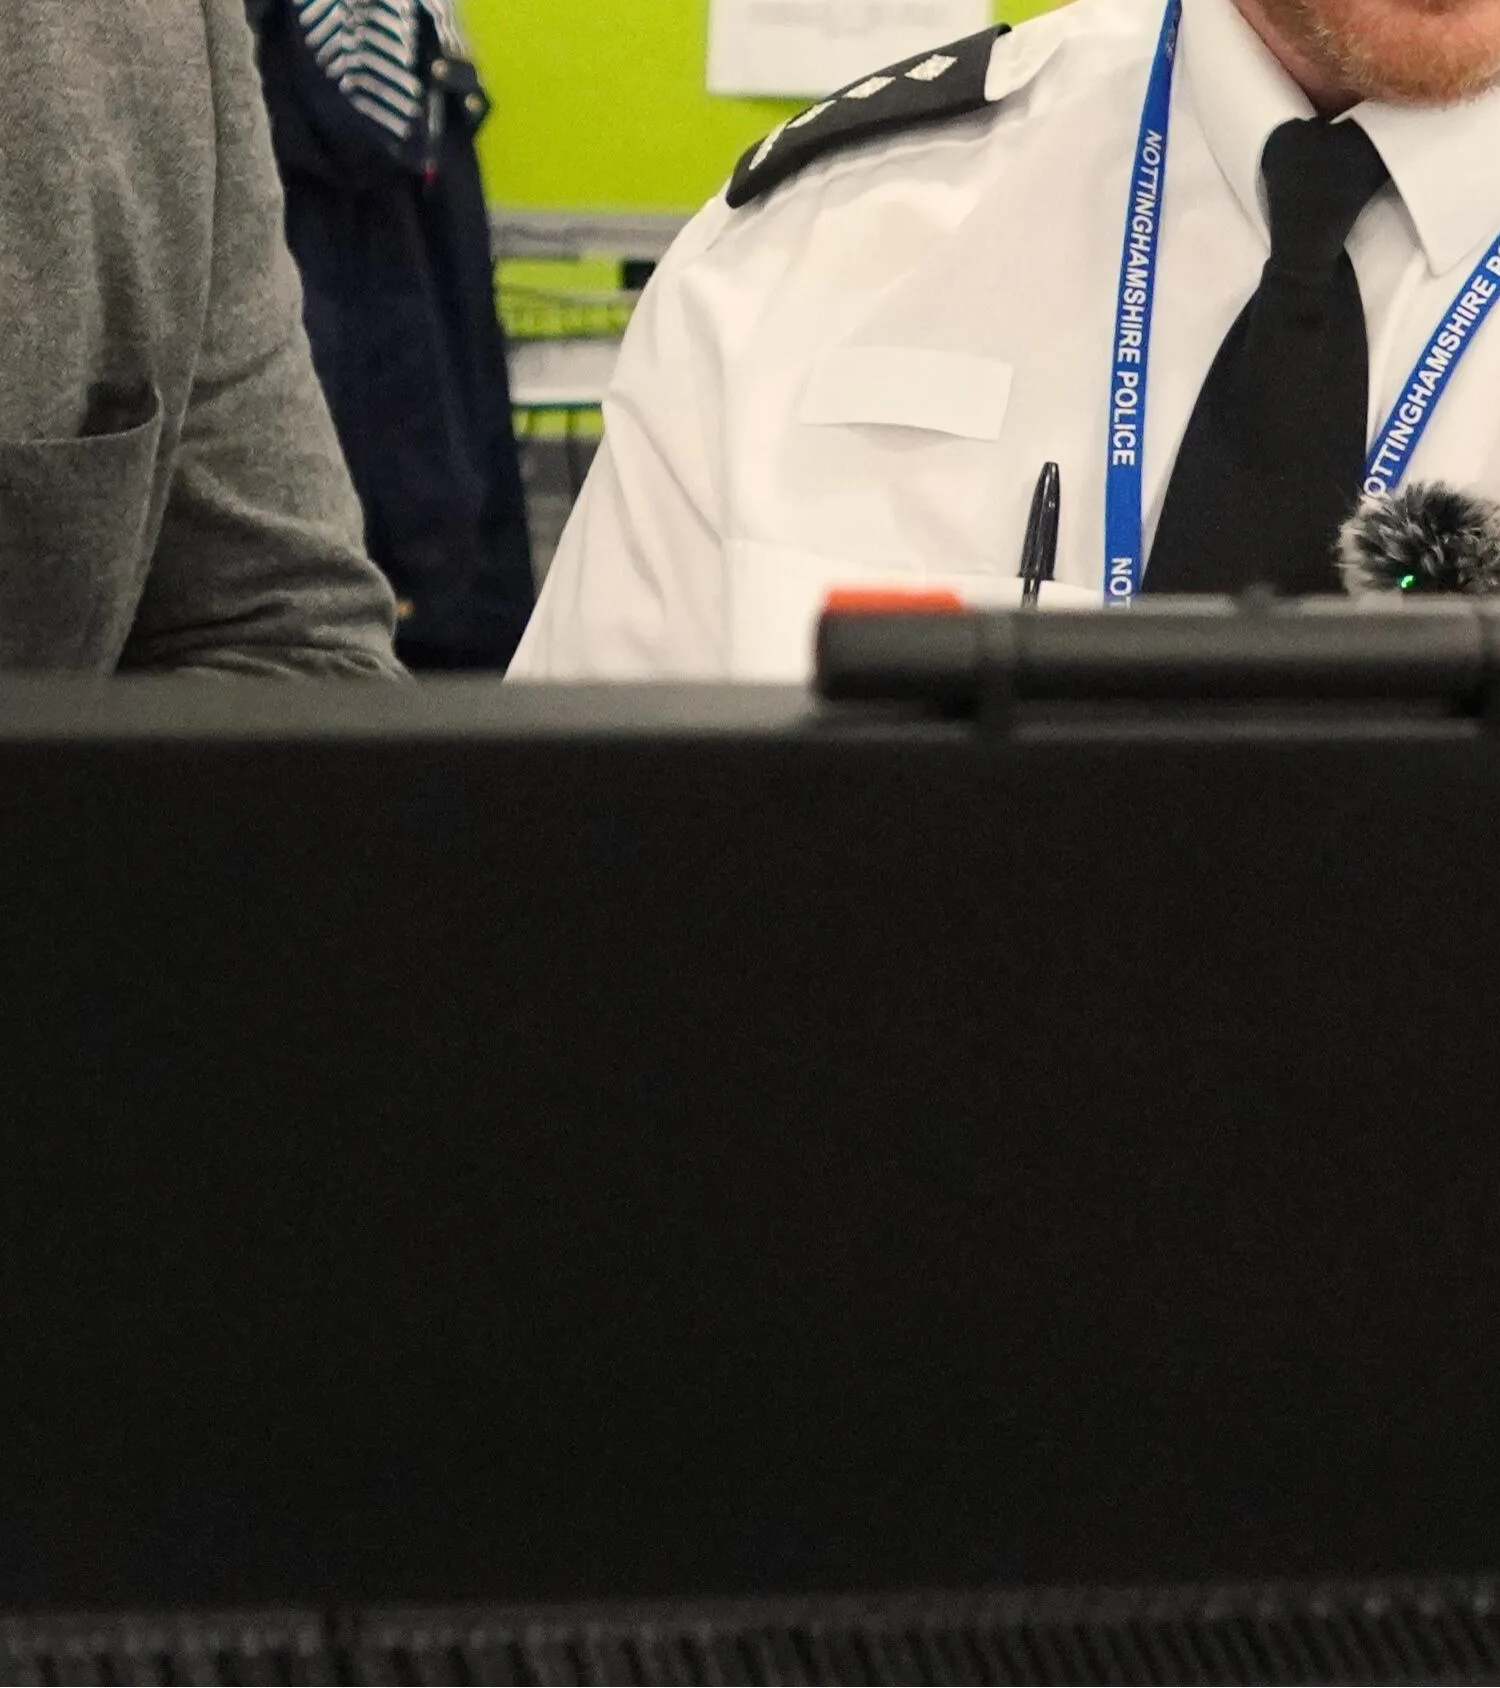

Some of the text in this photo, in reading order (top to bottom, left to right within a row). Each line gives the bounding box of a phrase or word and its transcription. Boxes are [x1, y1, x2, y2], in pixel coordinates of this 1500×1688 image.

[1112, 129, 1162, 466] NOTTINGHAMSHIRE POLICE
[1363, 274, 1496, 500] OTTINGHAMSHIRE
